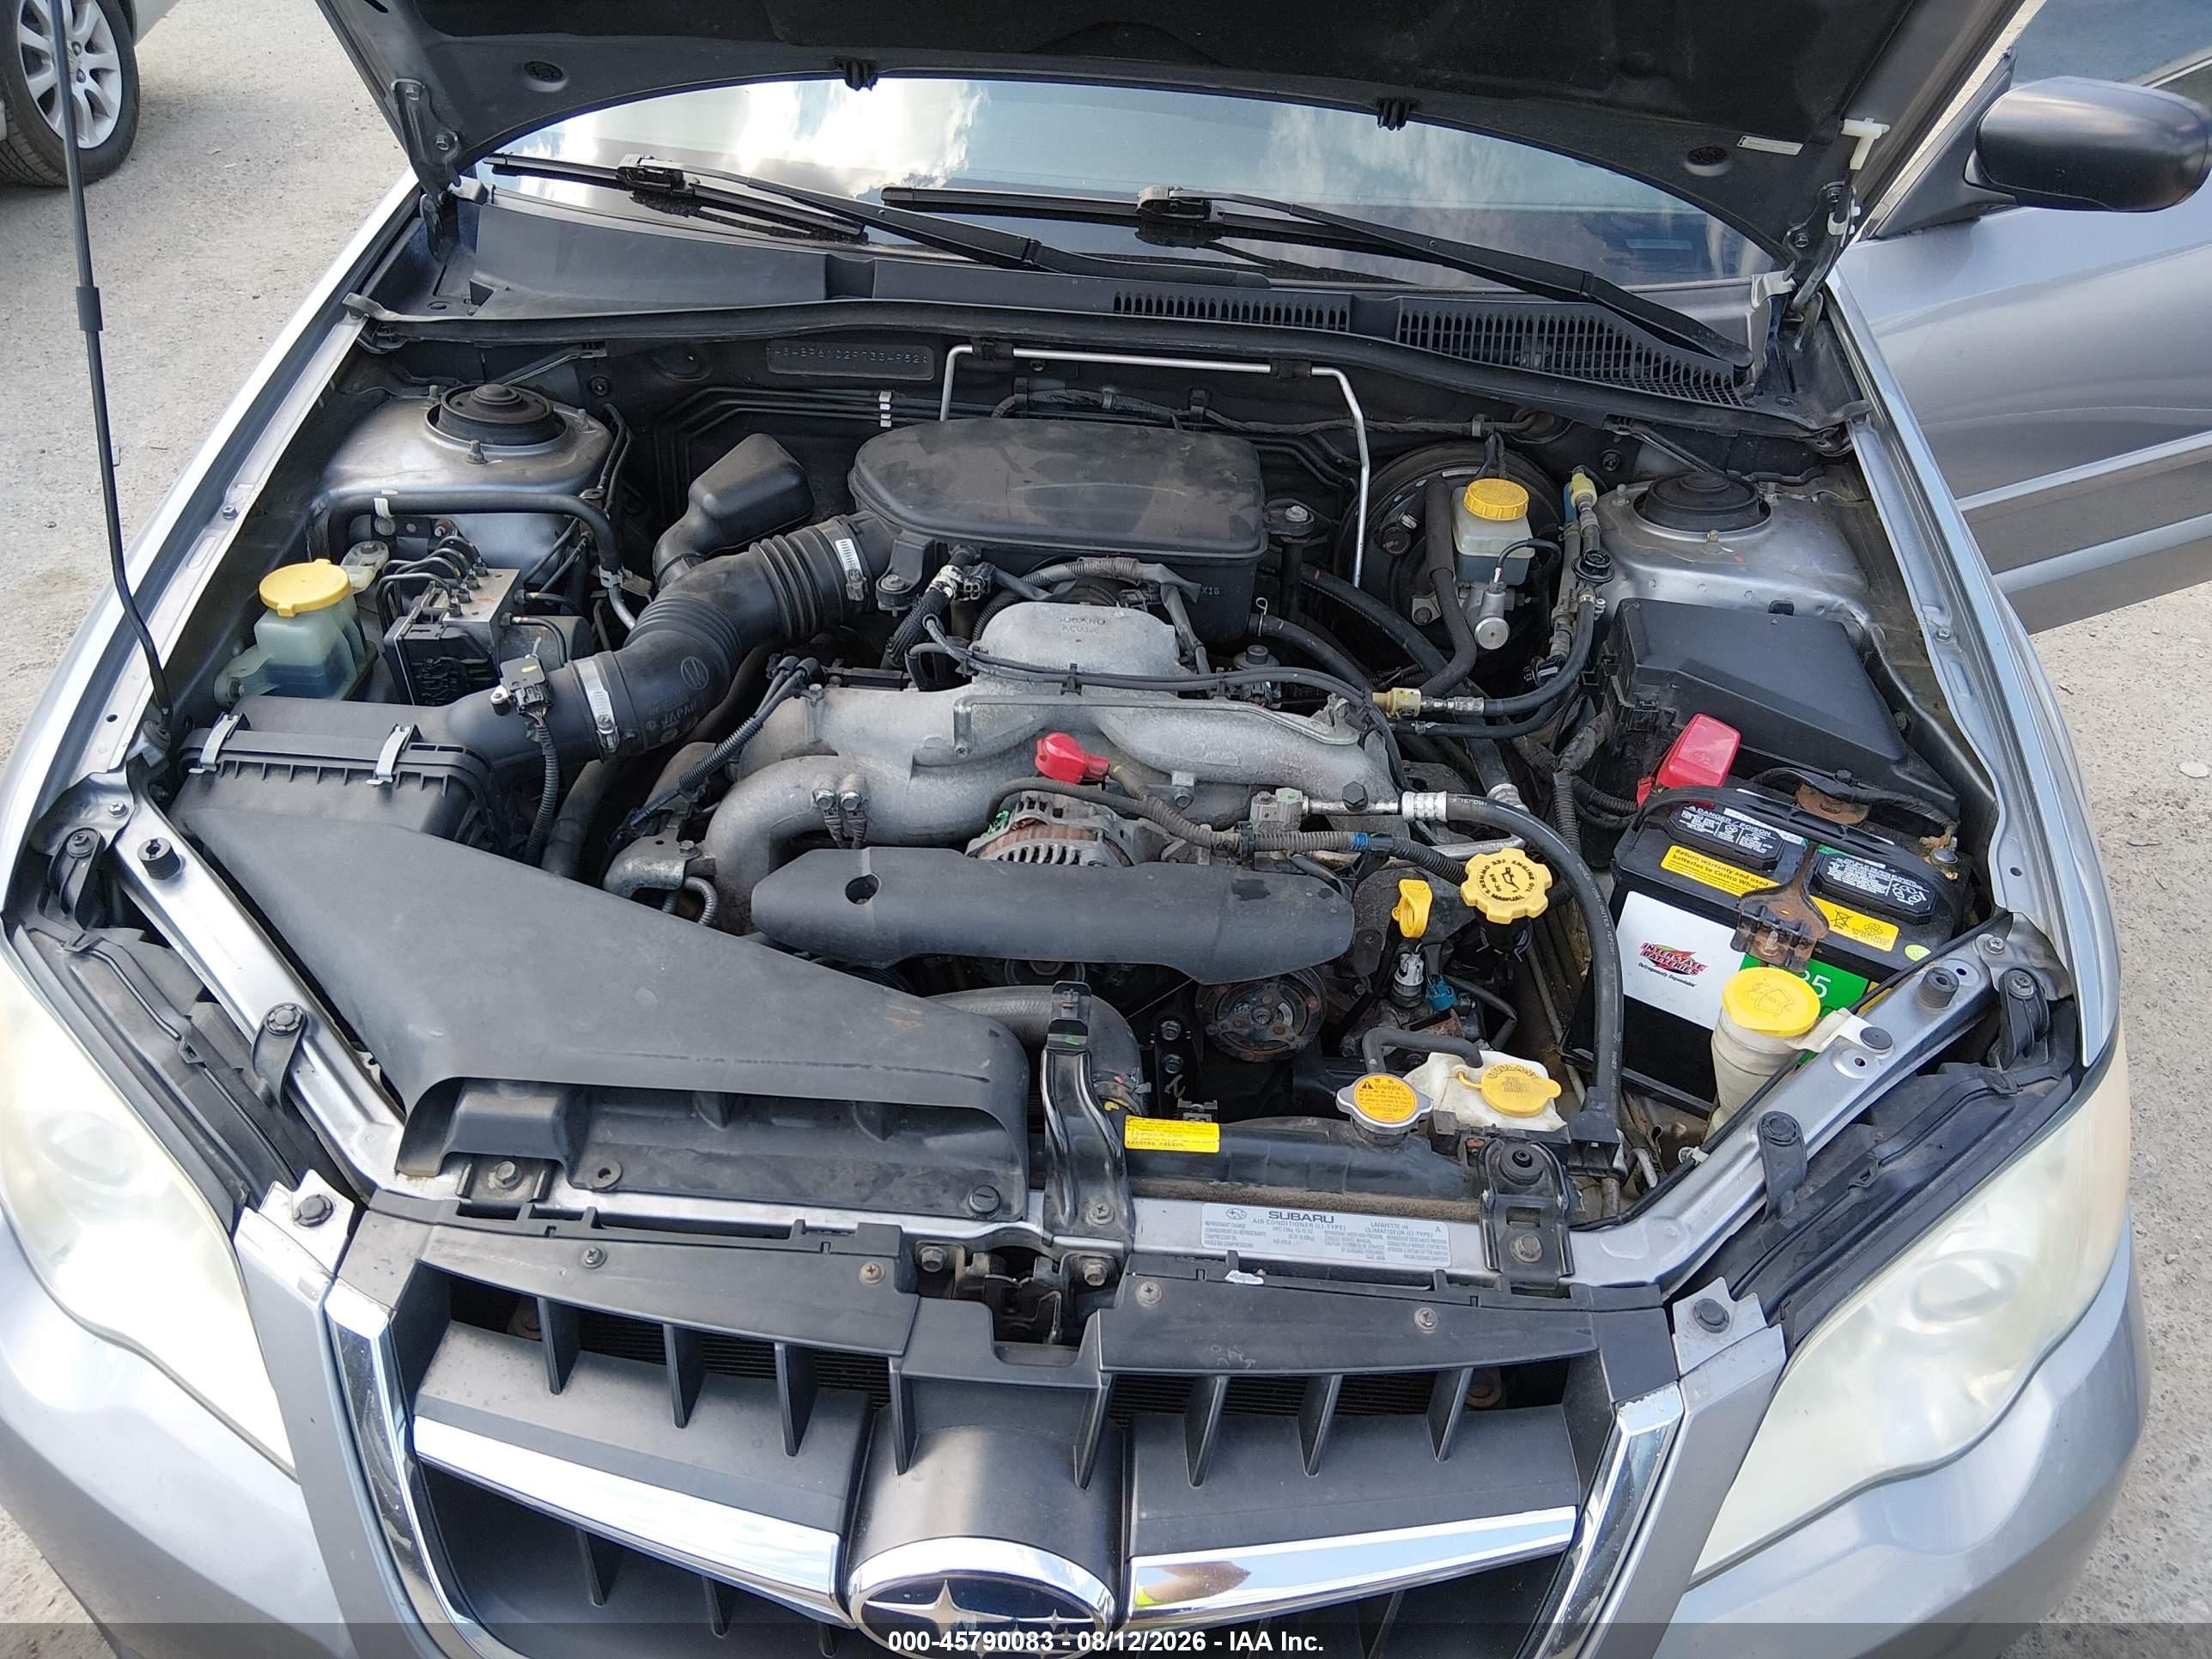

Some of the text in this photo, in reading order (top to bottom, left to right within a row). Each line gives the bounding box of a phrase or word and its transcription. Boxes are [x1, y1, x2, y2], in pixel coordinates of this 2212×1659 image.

[1696, 806, 1731, 823] DANGER
[1674, 848, 1769, 887] Return warranty and used
[1640, 941, 1707, 971] INTERSTATE
[1266, 1218, 1314, 1228] CONDITIONER
[1267, 1210, 1334, 1224] SUBARU
